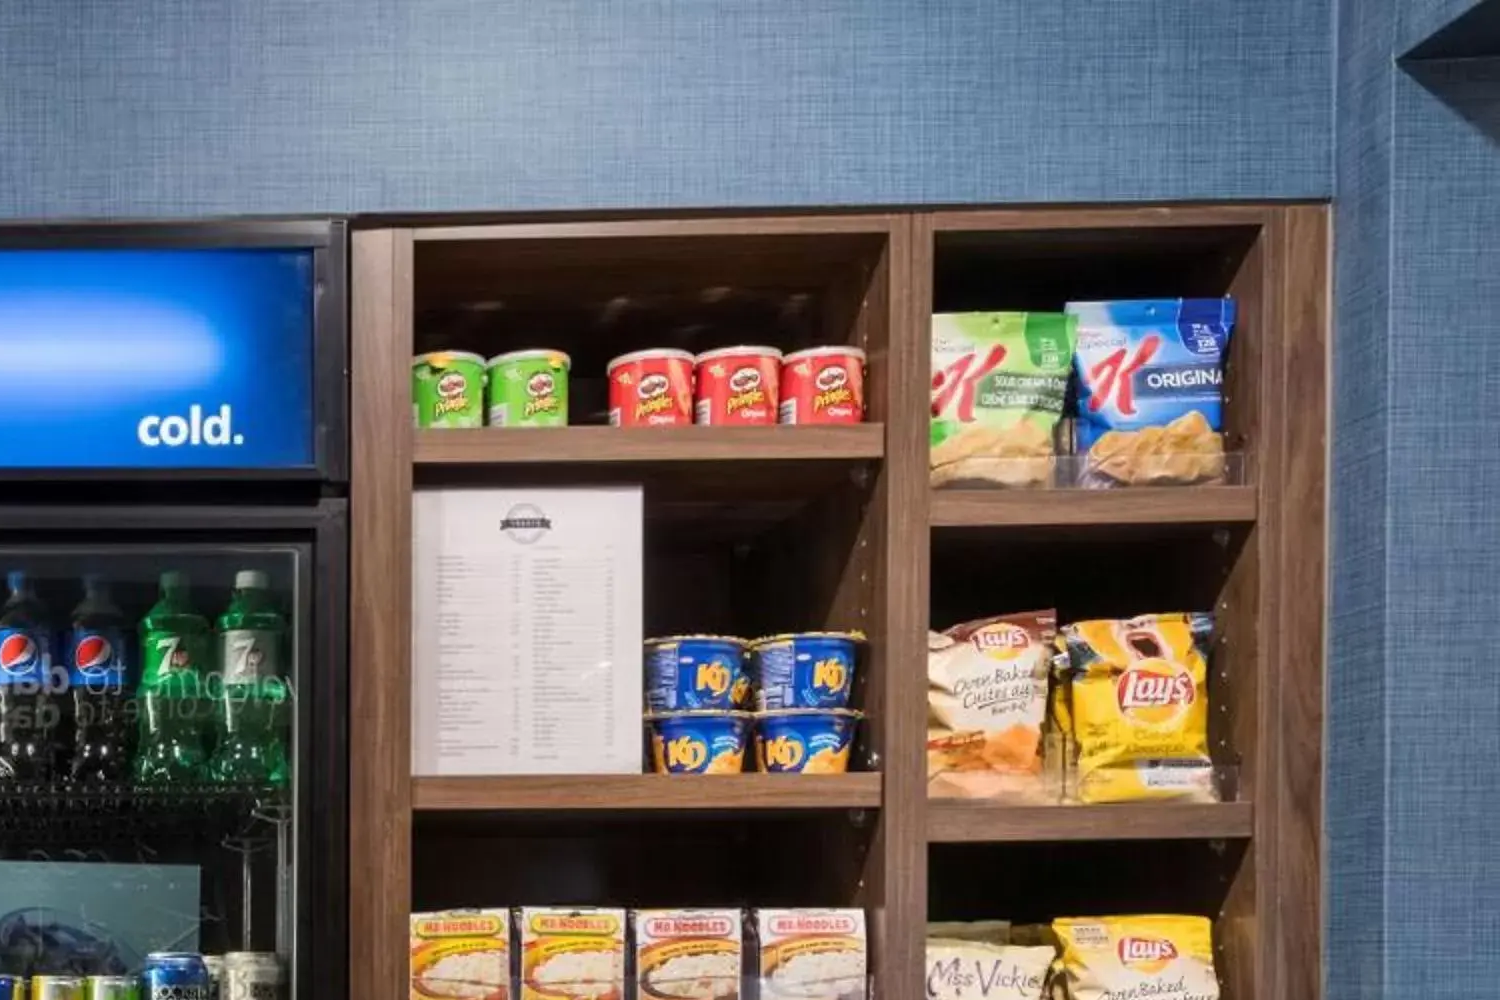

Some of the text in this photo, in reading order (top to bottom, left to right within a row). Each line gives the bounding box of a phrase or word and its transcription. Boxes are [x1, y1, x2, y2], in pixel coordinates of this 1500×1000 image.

[1087, 335, 1162, 415] K
[138, 403, 244, 446] cold.
[1123, 670, 1190, 708] Lay's
[1122, 936, 1174, 962] Lay's
